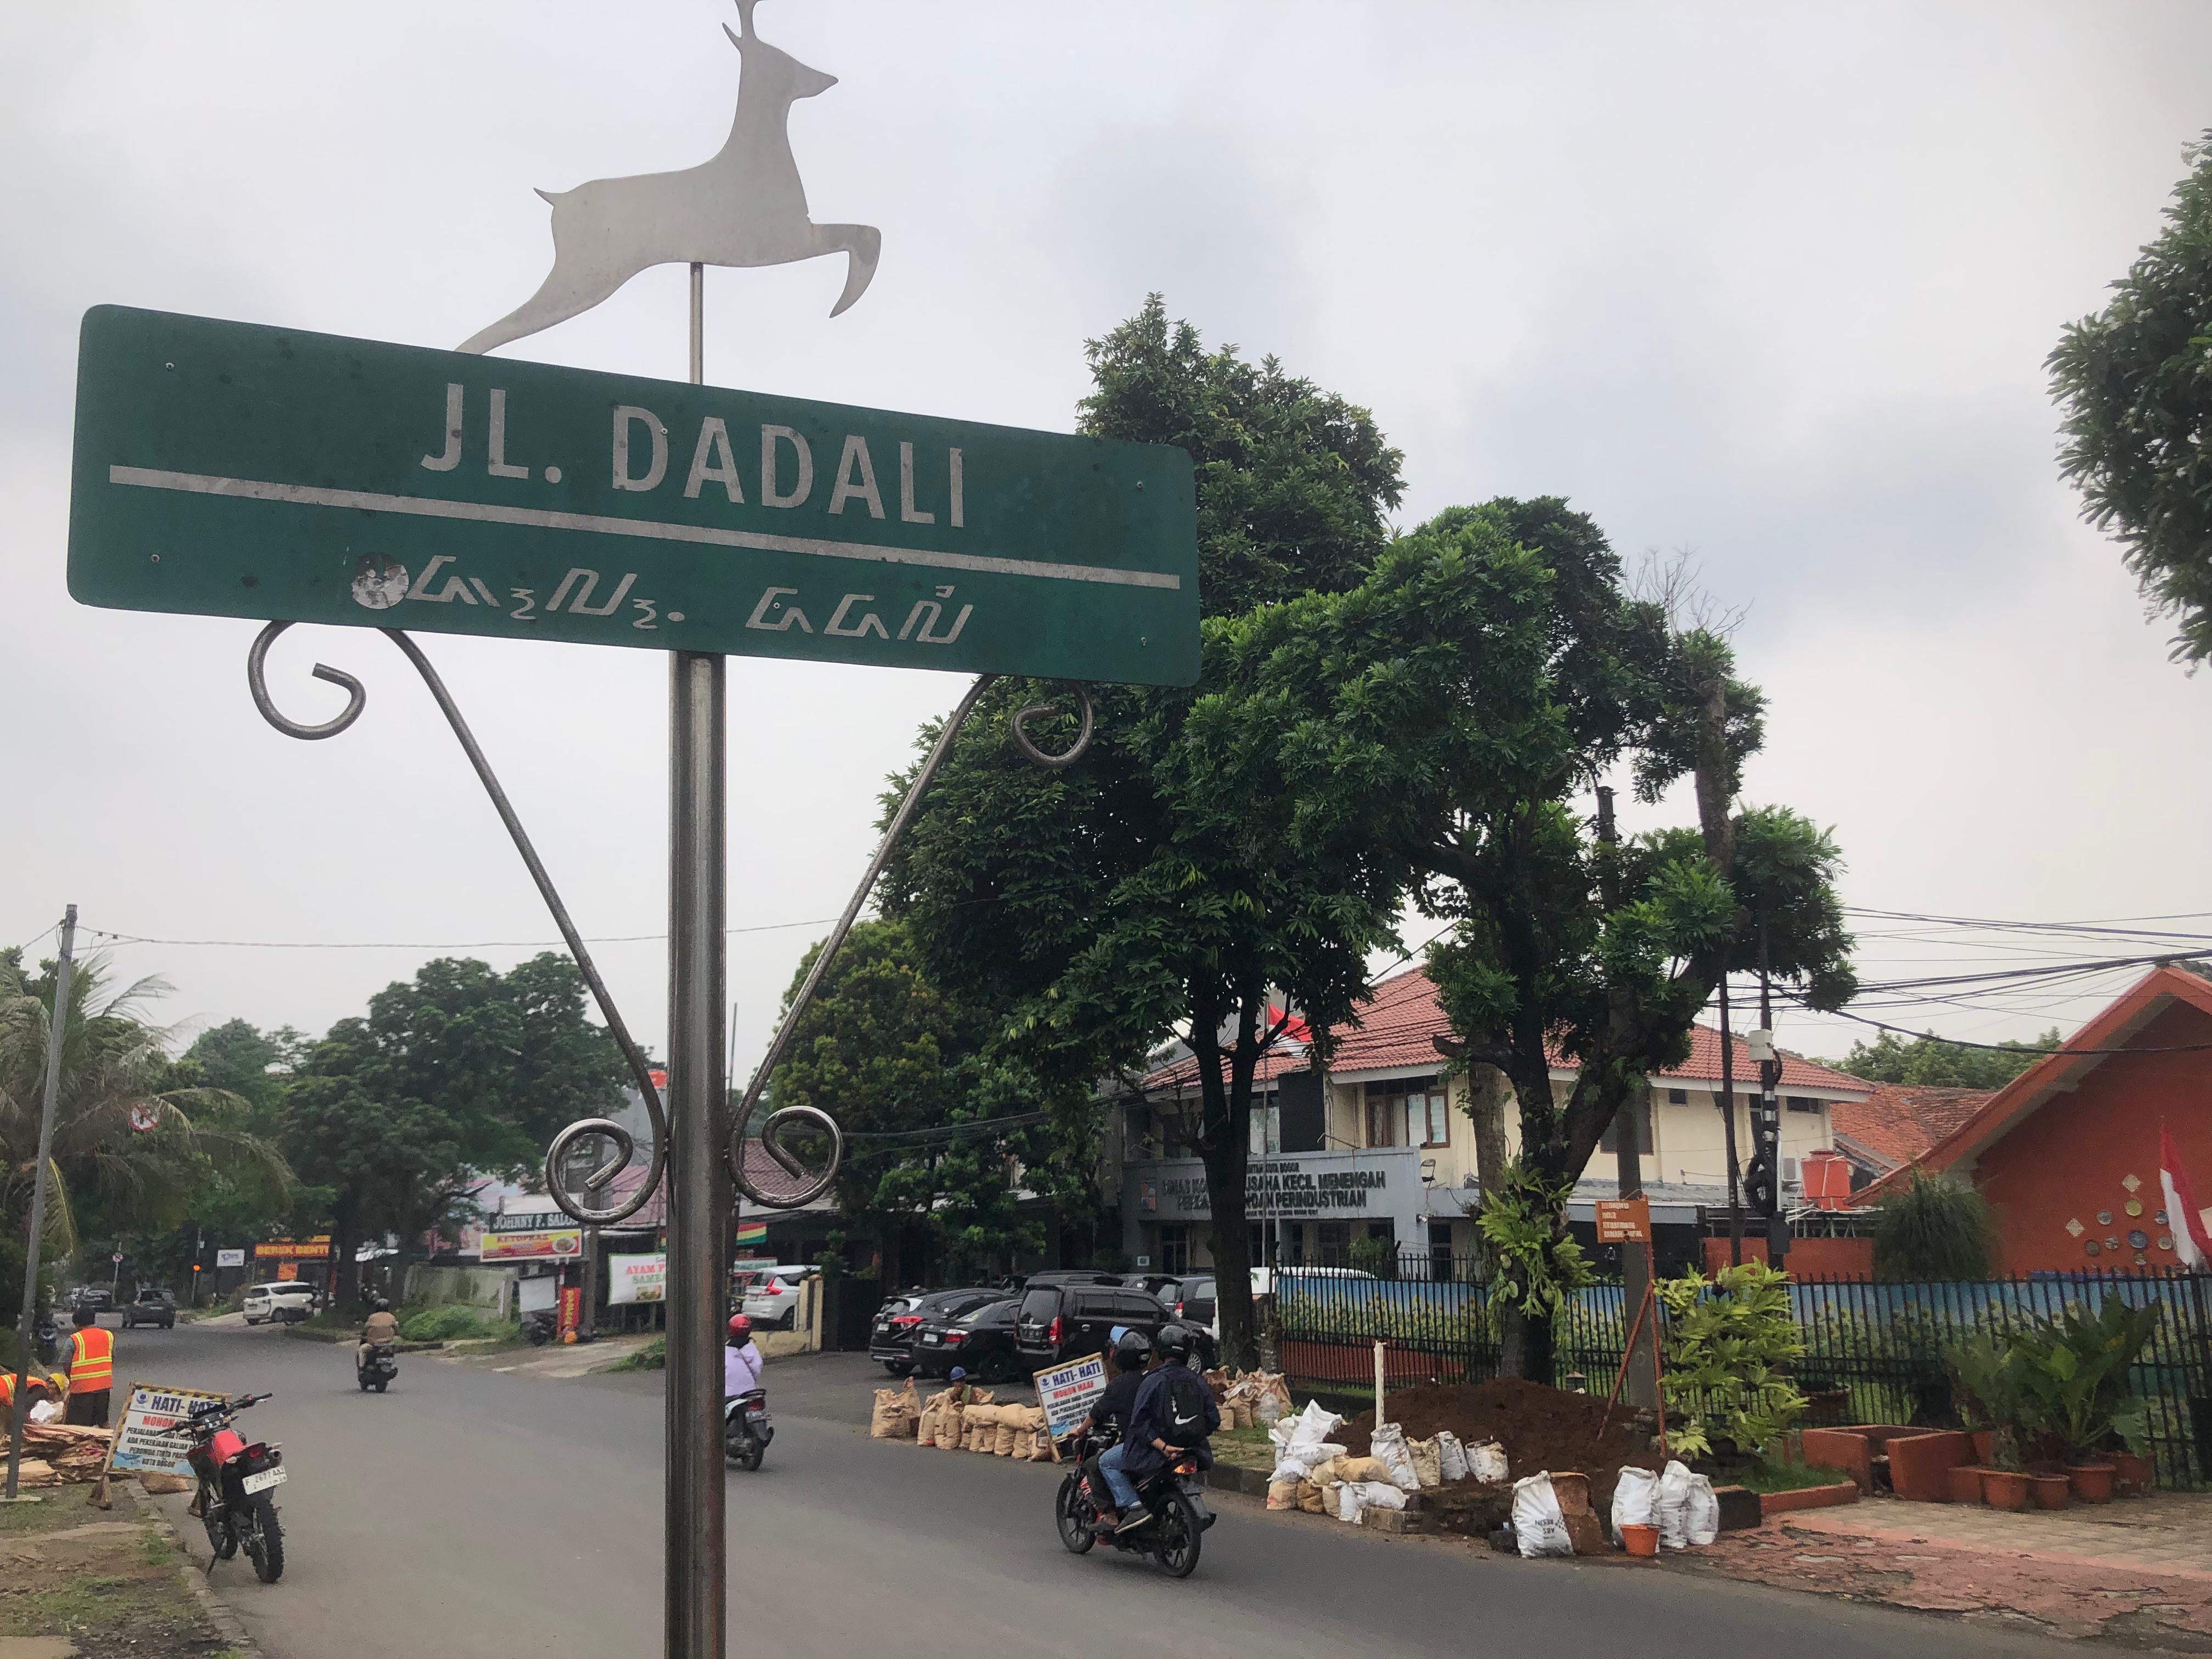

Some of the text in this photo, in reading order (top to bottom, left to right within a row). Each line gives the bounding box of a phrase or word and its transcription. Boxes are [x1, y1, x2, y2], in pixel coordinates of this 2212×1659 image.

[421, 383, 963, 528] JL. DADALI
[1282, 1173, 1317, 1190] KECIL
[1318, 1171, 1386, 1189] MENENGAH
[1276, 1189, 1367, 1208] PERINDUSTRIAN
[494, 1214, 534, 1229] JOHNNY
[627, 1264, 655, 1274] AYAM
[1078, 1362, 1101, 1378] HATI
[142, 1415, 176, 1428] MOHON
